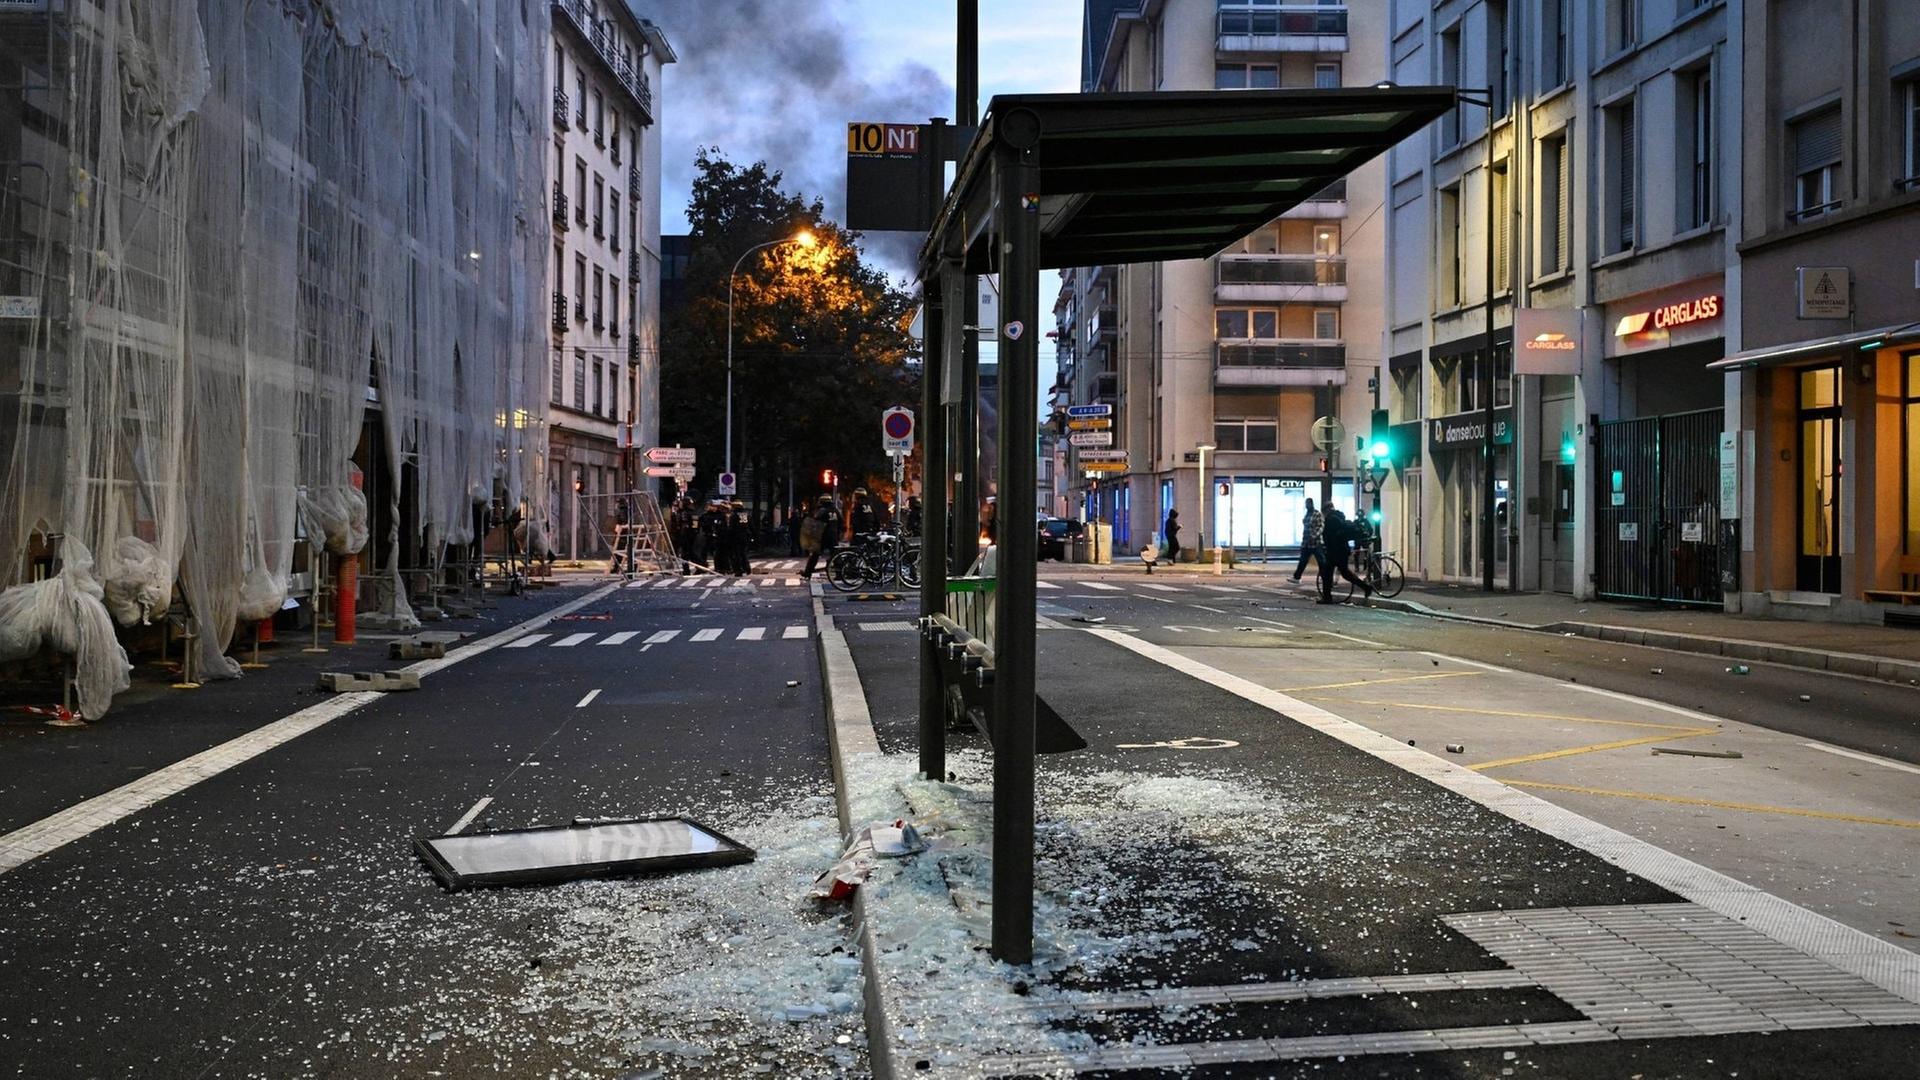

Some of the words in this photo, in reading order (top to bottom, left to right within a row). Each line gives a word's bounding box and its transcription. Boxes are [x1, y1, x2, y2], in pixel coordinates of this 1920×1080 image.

[850, 124, 883, 152] 10
[888, 127, 916, 149] N1
[1654, 296, 1718, 329] CARGLASS
[1526, 341, 1575, 350] CARGLASS
[1446, 421, 1506, 442] dansebouue
